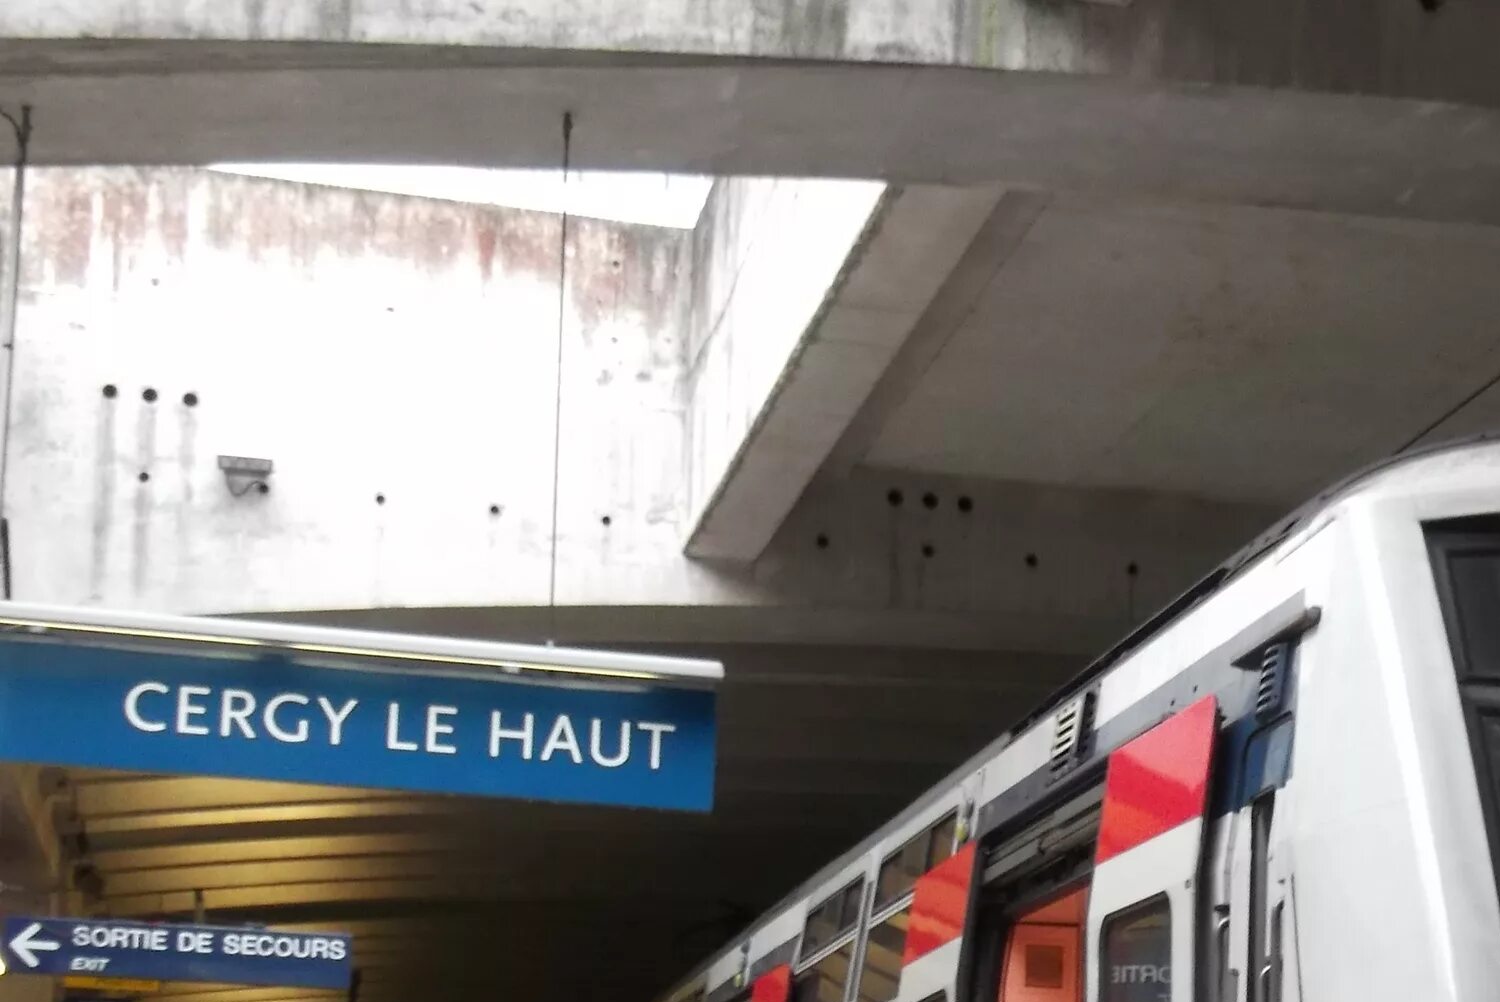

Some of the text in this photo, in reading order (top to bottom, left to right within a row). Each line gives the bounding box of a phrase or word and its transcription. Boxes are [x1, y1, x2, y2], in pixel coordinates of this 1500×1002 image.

[123, 681, 678, 771] CERGY LE HAUT
[72, 925, 346, 960] SORTIE DE SECOURS
[70, 956, 111, 972] EXIT
